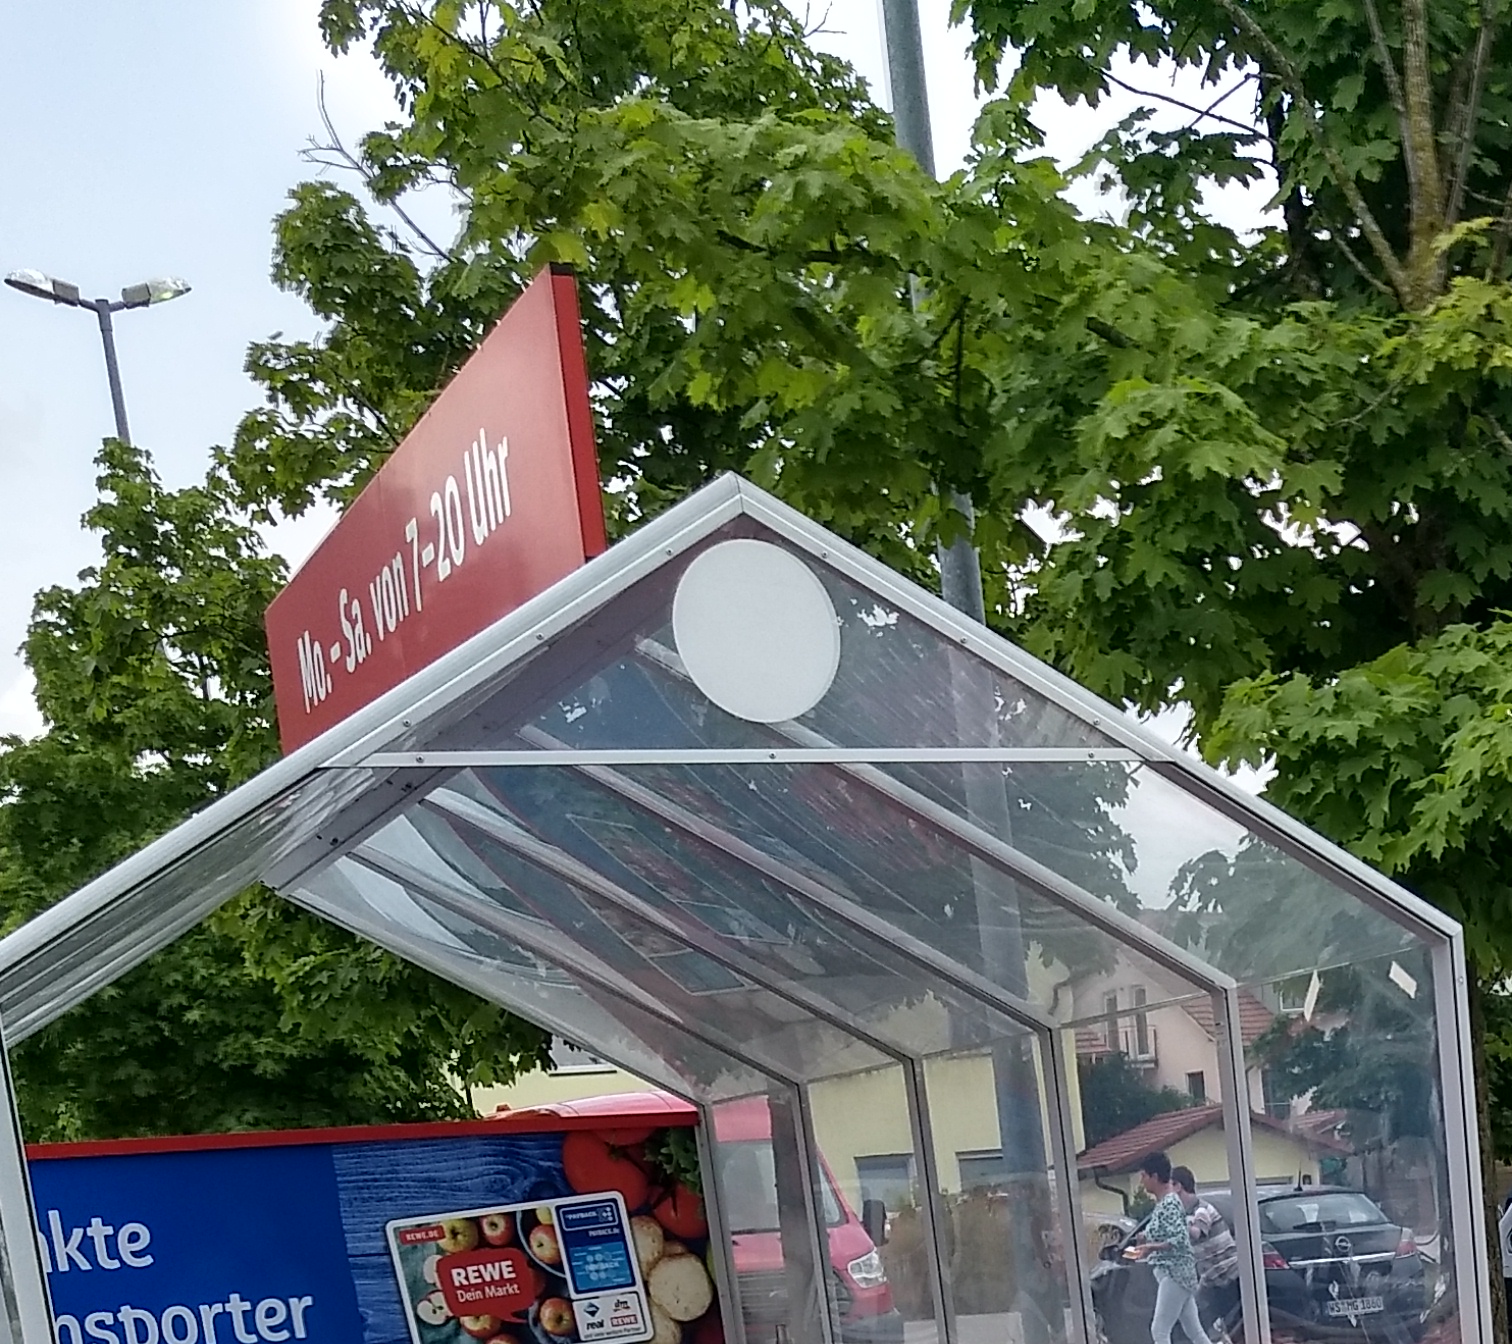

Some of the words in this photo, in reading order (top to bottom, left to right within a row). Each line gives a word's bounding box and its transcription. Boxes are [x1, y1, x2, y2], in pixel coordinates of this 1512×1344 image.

[369, 548, 409, 641] von
[405, 475, 465, 612] 7-20
[465, 427, 511, 547] Uhr
[405, 1230, 440, 1241] REWE.DE
[451, 1260, 517, 1287] REWE
[456, 1288, 485, 1303] Dein
[484, 1283, 520, 1299] Markt
[612, 1316, 637, 1327] REWE
